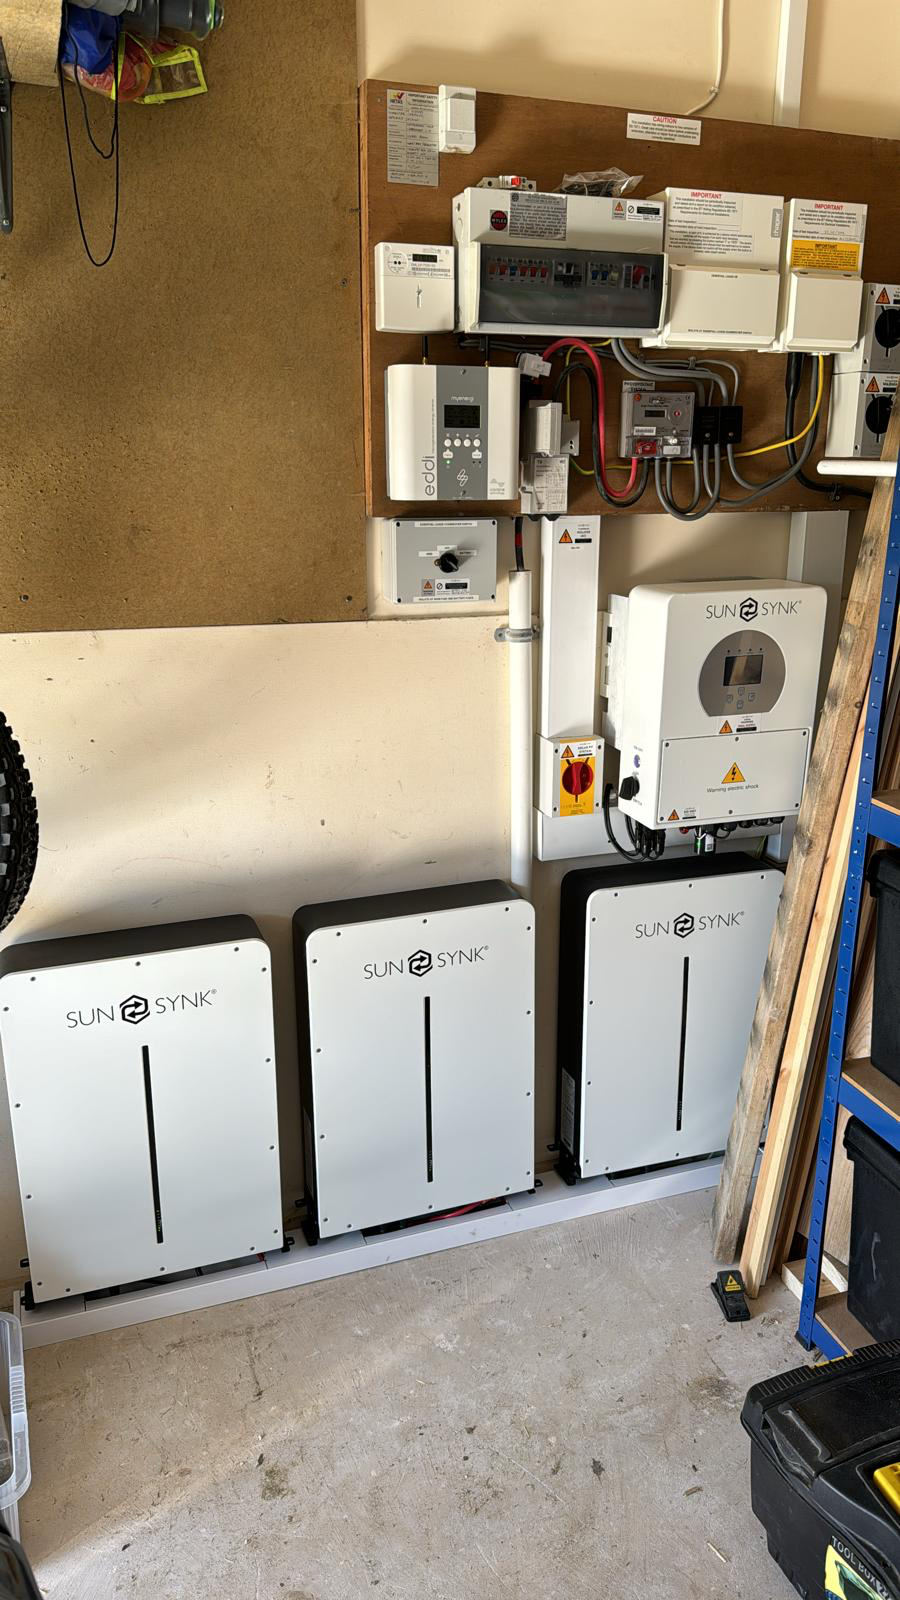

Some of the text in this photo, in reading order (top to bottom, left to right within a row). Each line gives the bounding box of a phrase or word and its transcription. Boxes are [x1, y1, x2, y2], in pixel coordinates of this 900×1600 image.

[421, 455, 435, 496] eddi
[706, 604, 736, 619] SUN
[707, 785, 727, 793] Warning
[745, 782, 759, 790] shock
[635, 921, 669, 939] SUN
[363, 960, 404, 980] SUN
[66, 1005, 115, 1028] SUN
[831, 1535, 856, 1565] TOOL
